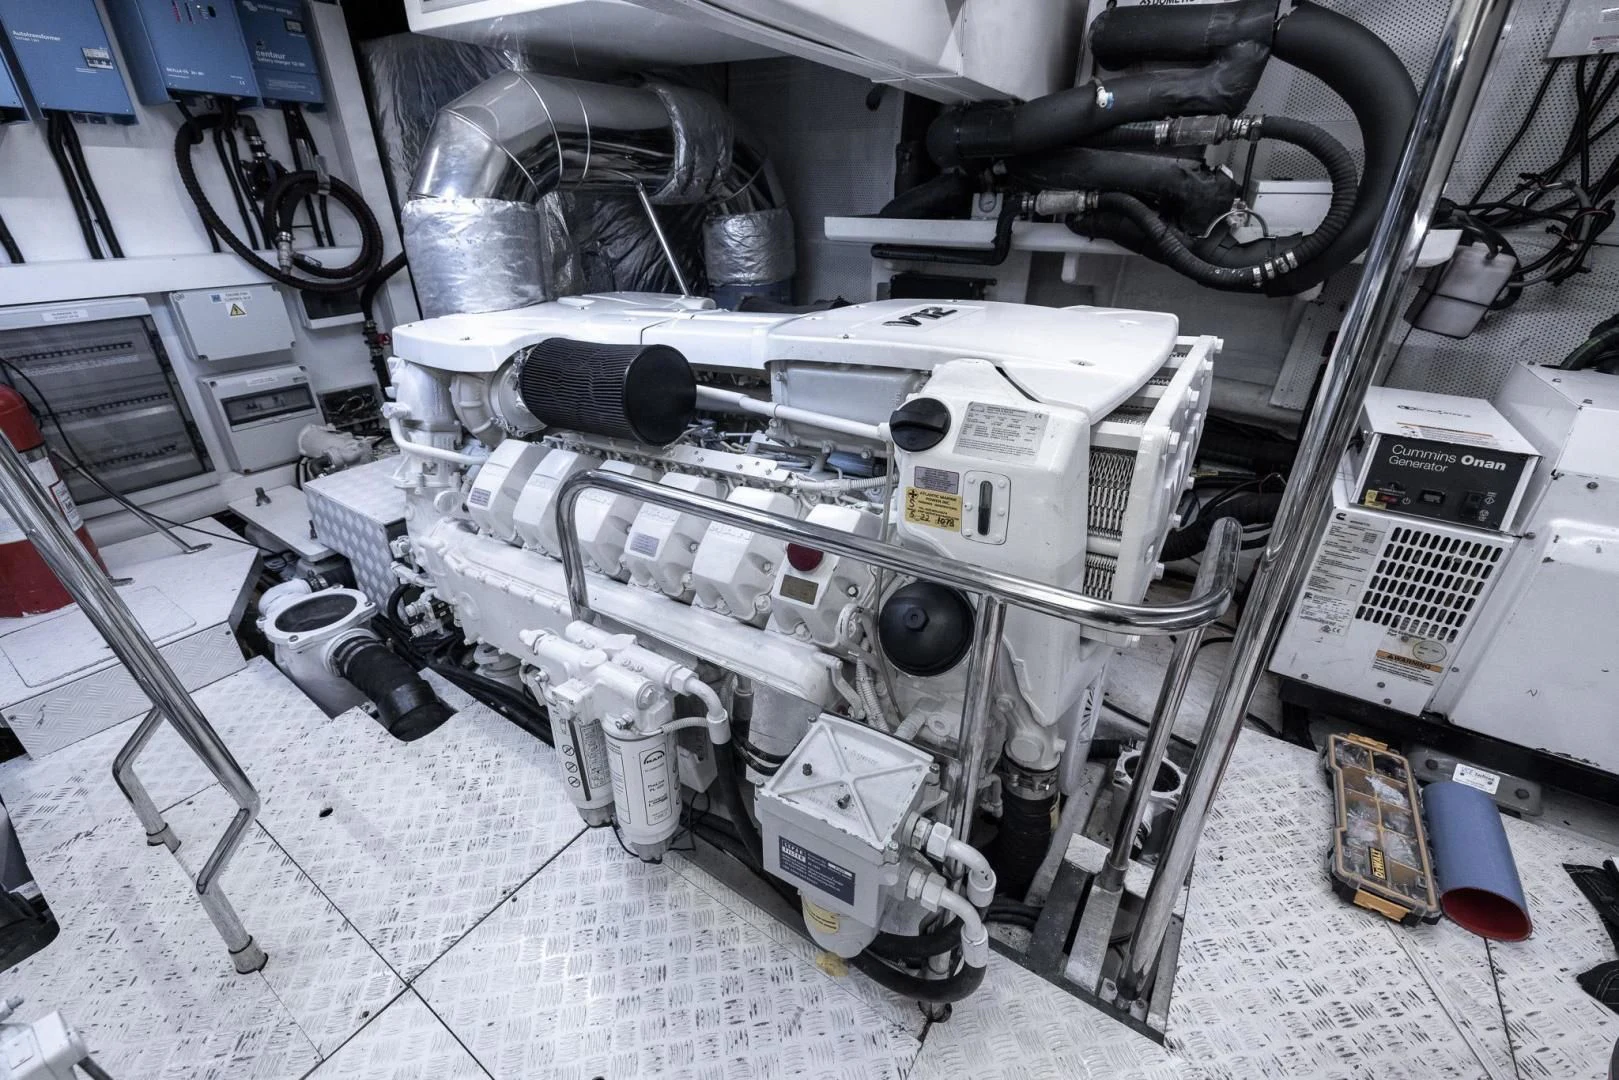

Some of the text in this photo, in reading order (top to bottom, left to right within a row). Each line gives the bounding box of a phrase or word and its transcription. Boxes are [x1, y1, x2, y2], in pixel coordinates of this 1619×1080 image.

[256, 50, 286, 60] centaur
[1388, 455, 1449, 473] Generator
[1391, 444, 1507, 471] Cummins Onan
[1394, 655, 1431, 669] WARNING
[646, 755, 663, 764] MAN
